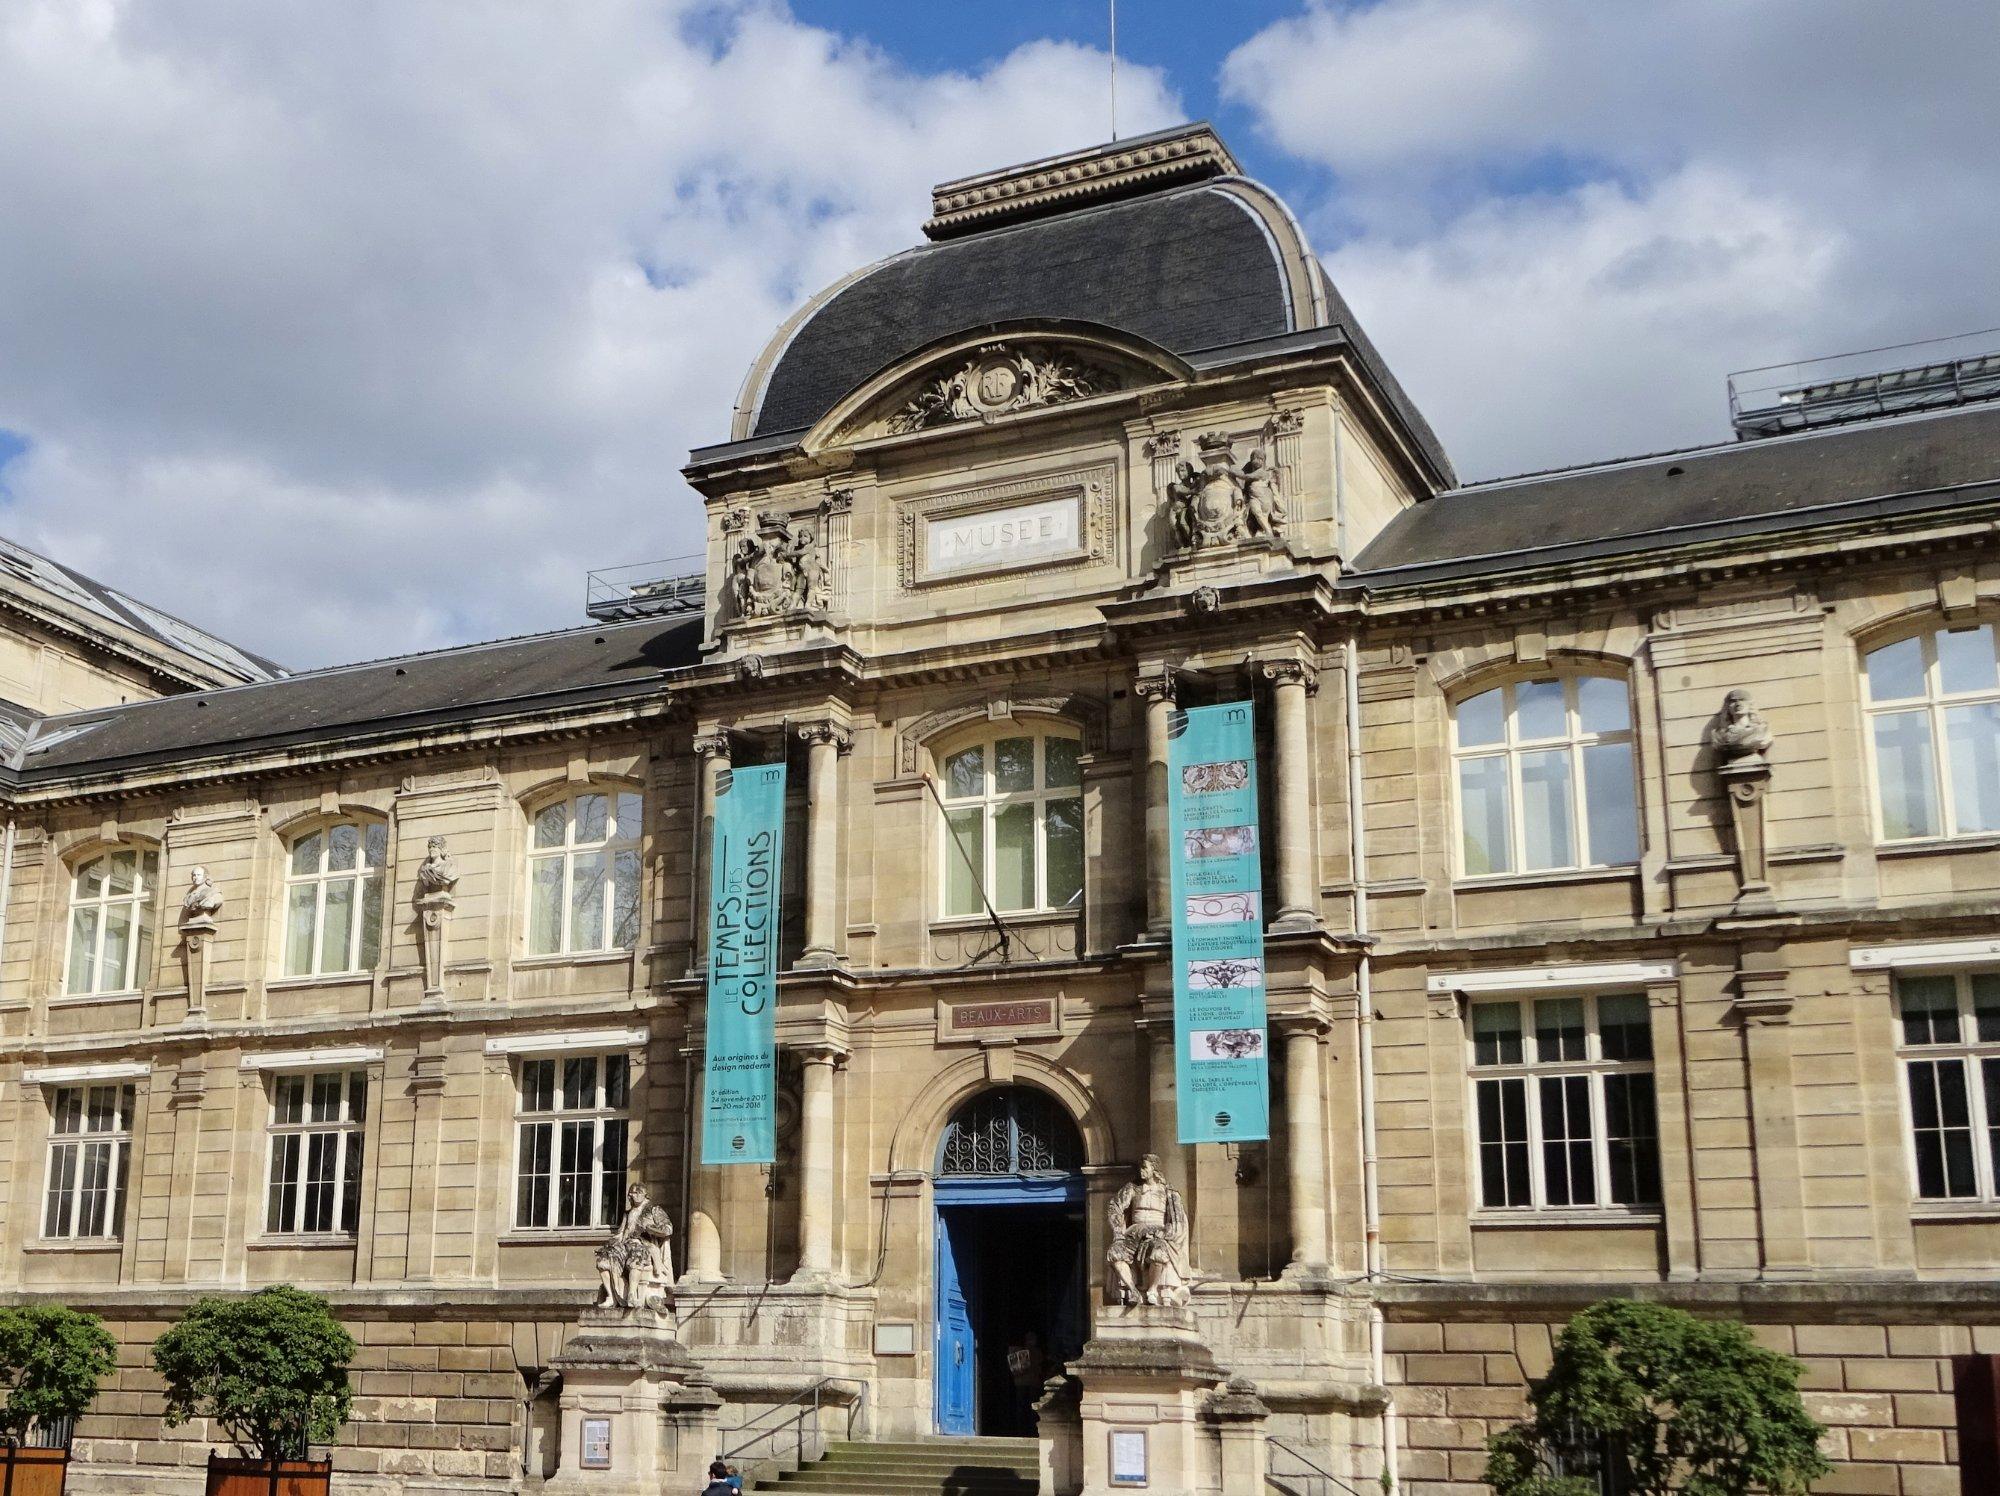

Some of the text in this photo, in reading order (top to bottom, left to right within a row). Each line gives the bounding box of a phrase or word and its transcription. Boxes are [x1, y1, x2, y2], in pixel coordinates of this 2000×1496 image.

[714, 896, 742, 986] TEMPS
[728, 867, 743, 893] DES
[741, 831, 771, 1016] COLLECTIONS
[960, 1006, 1042, 1023] BEAUX-ARTS
[712, 1050, 769, 1063] Aux origines du
[712, 1061, 771, 1073] design moderne
[720, 1095, 750, 1103] novembre
[751, 1094, 767, 1102] 2017
